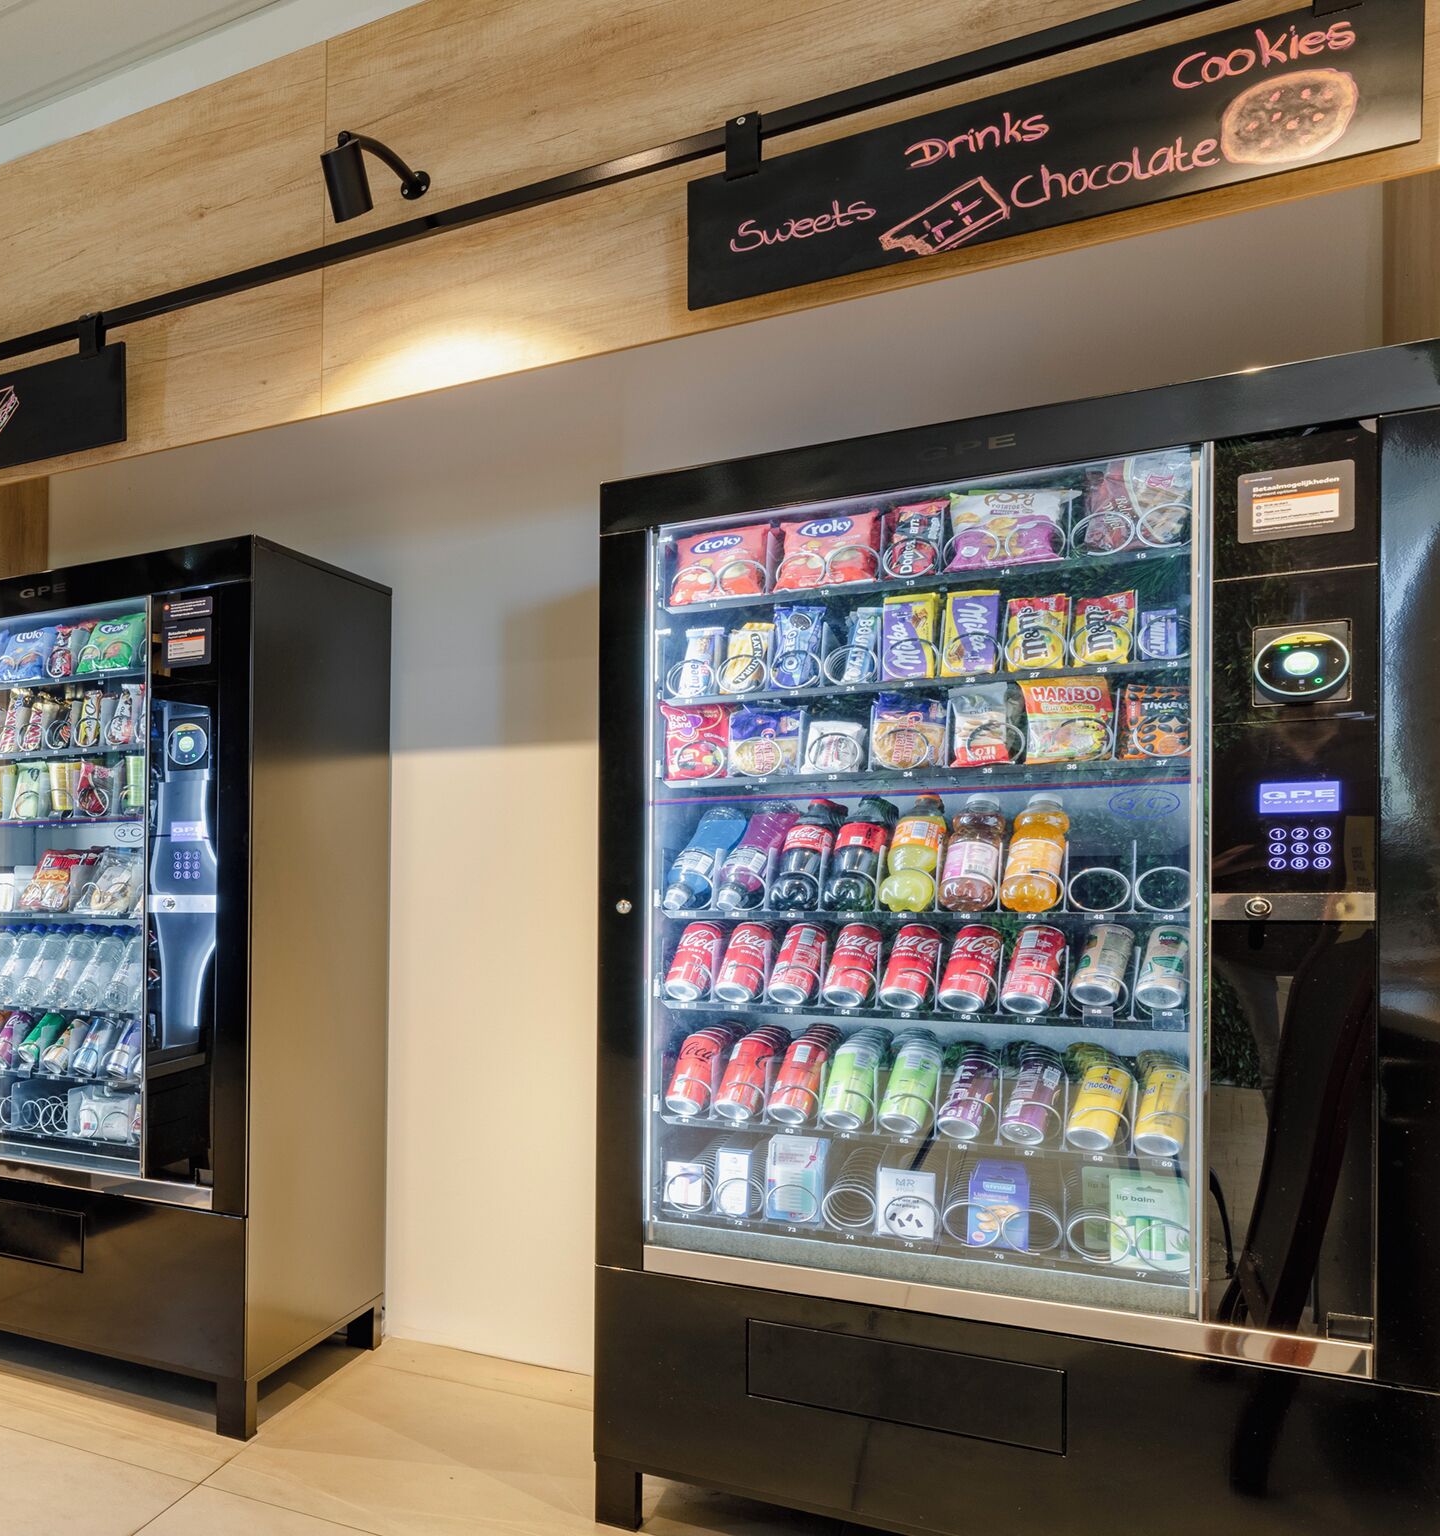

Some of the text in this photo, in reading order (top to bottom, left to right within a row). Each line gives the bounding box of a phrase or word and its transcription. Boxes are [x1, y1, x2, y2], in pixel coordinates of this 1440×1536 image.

[1171, 19, 1357, 90] Cookies
[904, 111, 1050, 170] Drinks
[1009, 135, 1222, 210] Chocolate
[729, 197, 877, 254] Sweets
[1252, 476, 1340, 493] Betaalmogelijkheden
[800, 519, 852, 536] Croky
[694, 537, 741, 553] Croky
[19, 582, 67, 600] GPE
[958, 603, 989, 653] Milka
[886, 622, 922, 670] Milka
[1032, 686, 1101, 701] HARIBO
[669, 714, 687, 723] Red
[669, 721, 692, 730] Band
[1262, 789, 1336, 800] GPE
[1275, 829, 1326, 838] 1 2 3
[1273, 844, 1326, 853] 4 5 6
[1274, 859, 1326, 868] 7 8 9
[1116, 1193, 1156, 1204] lip balm
